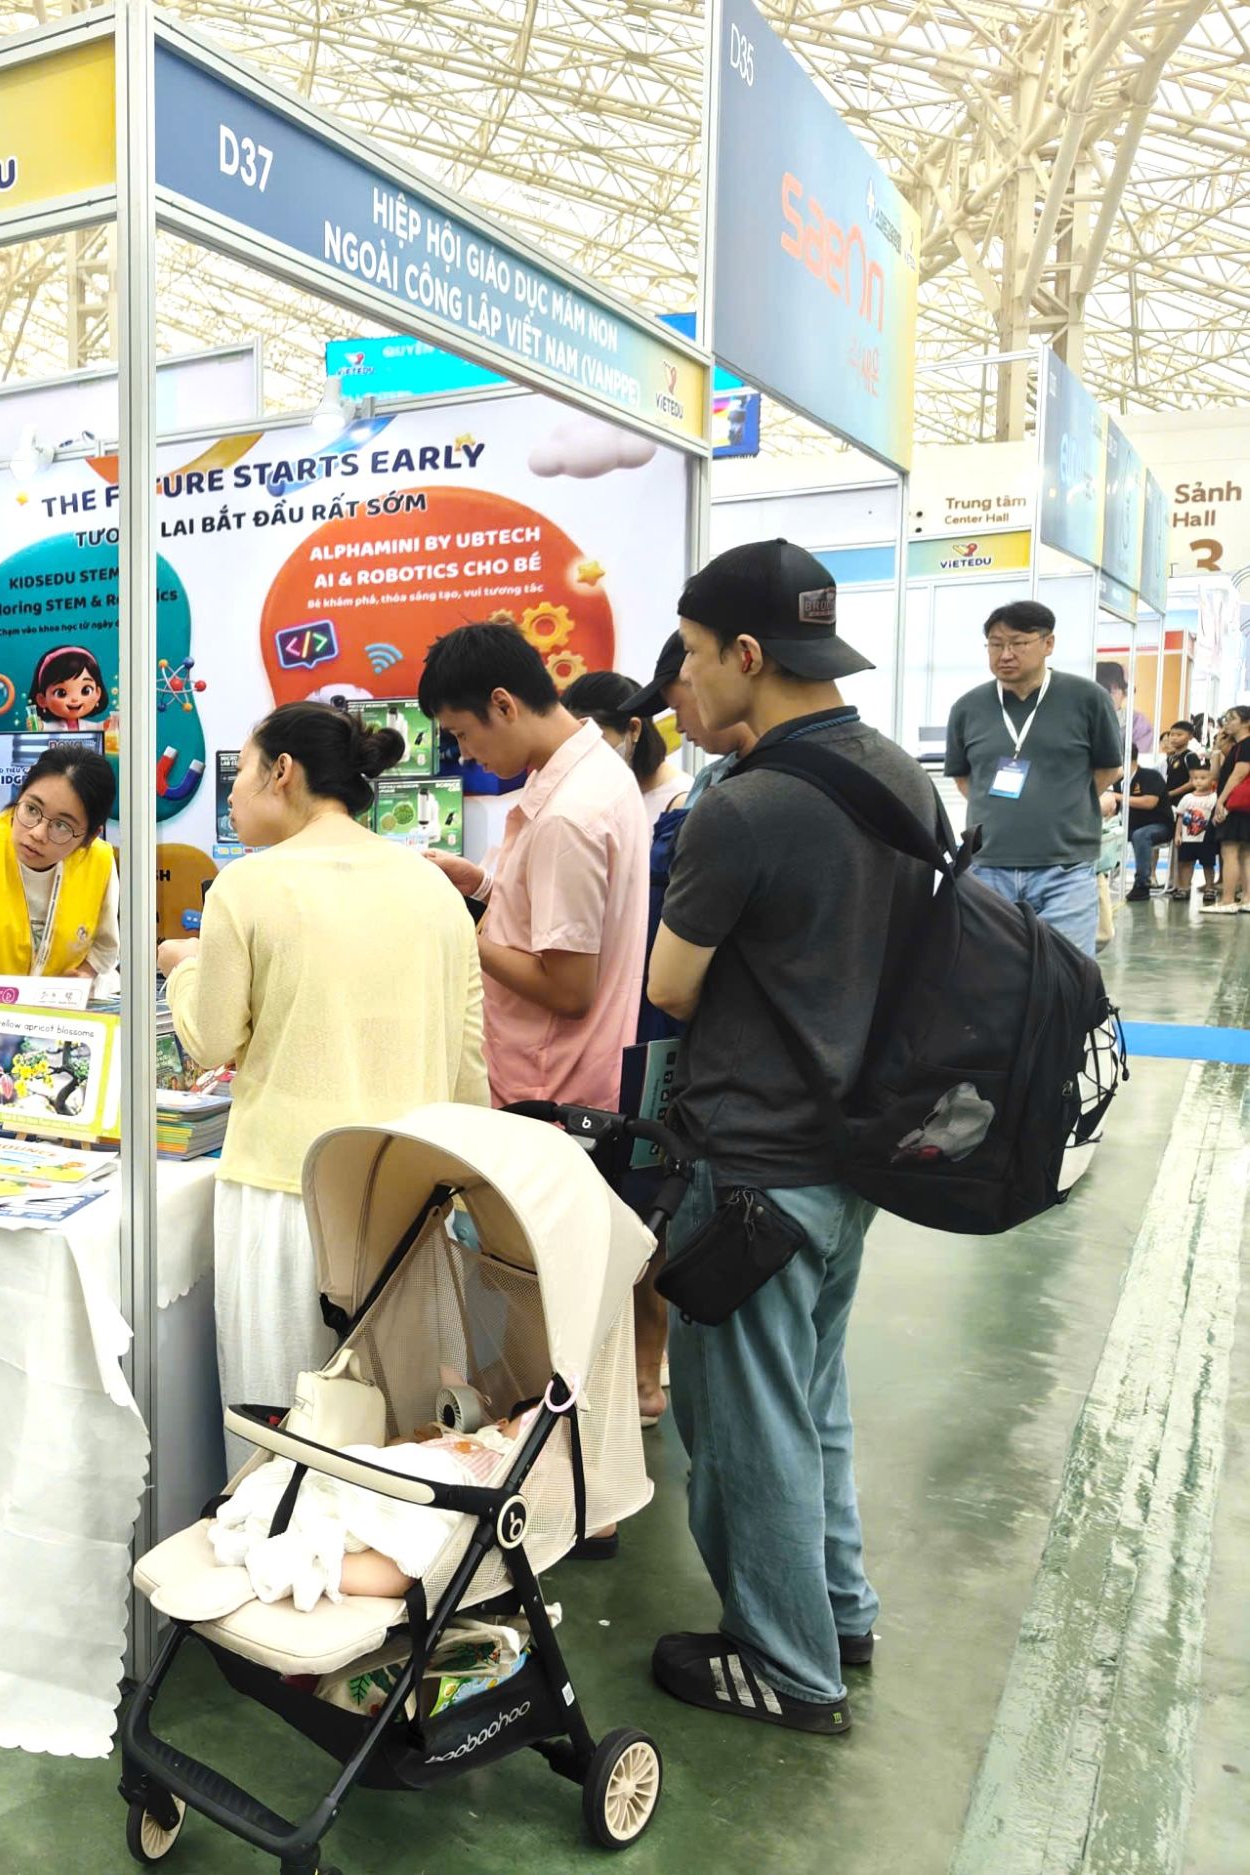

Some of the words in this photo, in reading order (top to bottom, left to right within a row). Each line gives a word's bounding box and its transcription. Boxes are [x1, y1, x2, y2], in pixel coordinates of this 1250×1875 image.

[729, 22, 754, 87] D35
[220, 124, 273, 193] D37
[373, 187, 421, 249] HIỆP
[427, 219, 461, 273] HỘI
[466, 244, 511, 294] GIÁO
[515, 273, 548, 317] DỤC
[589, 315, 618, 352] NON
[324, 220, 397, 292] NGOÀI
[405, 262, 462, 321] CÔNG
[467, 293, 501, 339] LẬP
[506, 312, 542, 359] VIỆT
[546, 335, 579, 378] NAM
[581, 355, 641, 408] (VANPPE)
[41, 489, 97, 518] THE
[106, 468, 225, 508] FURE
[234, 453, 360, 489] STARTS
[371, 443, 485, 475] EARLY
[1175, 480, 1242, 504] Sảnh
[161, 518, 194, 538] LAI
[202, 505, 247, 534] BẮT
[253, 499, 304, 527] ĐẦU
[312, 494, 360, 521] RẤT
[367, 490, 427, 516] SỚM
[946, 497, 992, 512] Trung
[996, 495, 1027, 508] tâm
[944, 514, 982, 526] Center
[986, 513, 1009, 523] Hall
[1173, 510, 1216, 528] Hall
[309, 536, 419, 561] ALPHAMINI
[425, 534, 452, 551] BY
[456, 526, 540, 548] UBTECH
[9, 571, 75, 590] KIDSEDU
[80, 567, 119, 584] STEM
[314, 573, 333, 589] AI
[338, 571, 352, 587] &
[357, 562, 459, 586] ROBOTICS
[463, 558, 509, 578] CHO
[514, 551, 541, 572] BÉ
[46, 597, 86, 612] STEM
[91, 595, 102, 607] &
[463, 586, 481, 598] vui
[38, 622, 59, 633] khoa
[24, 1020, 54, 1033] apricot
[57, 1025, 95, 1038] blossoms
